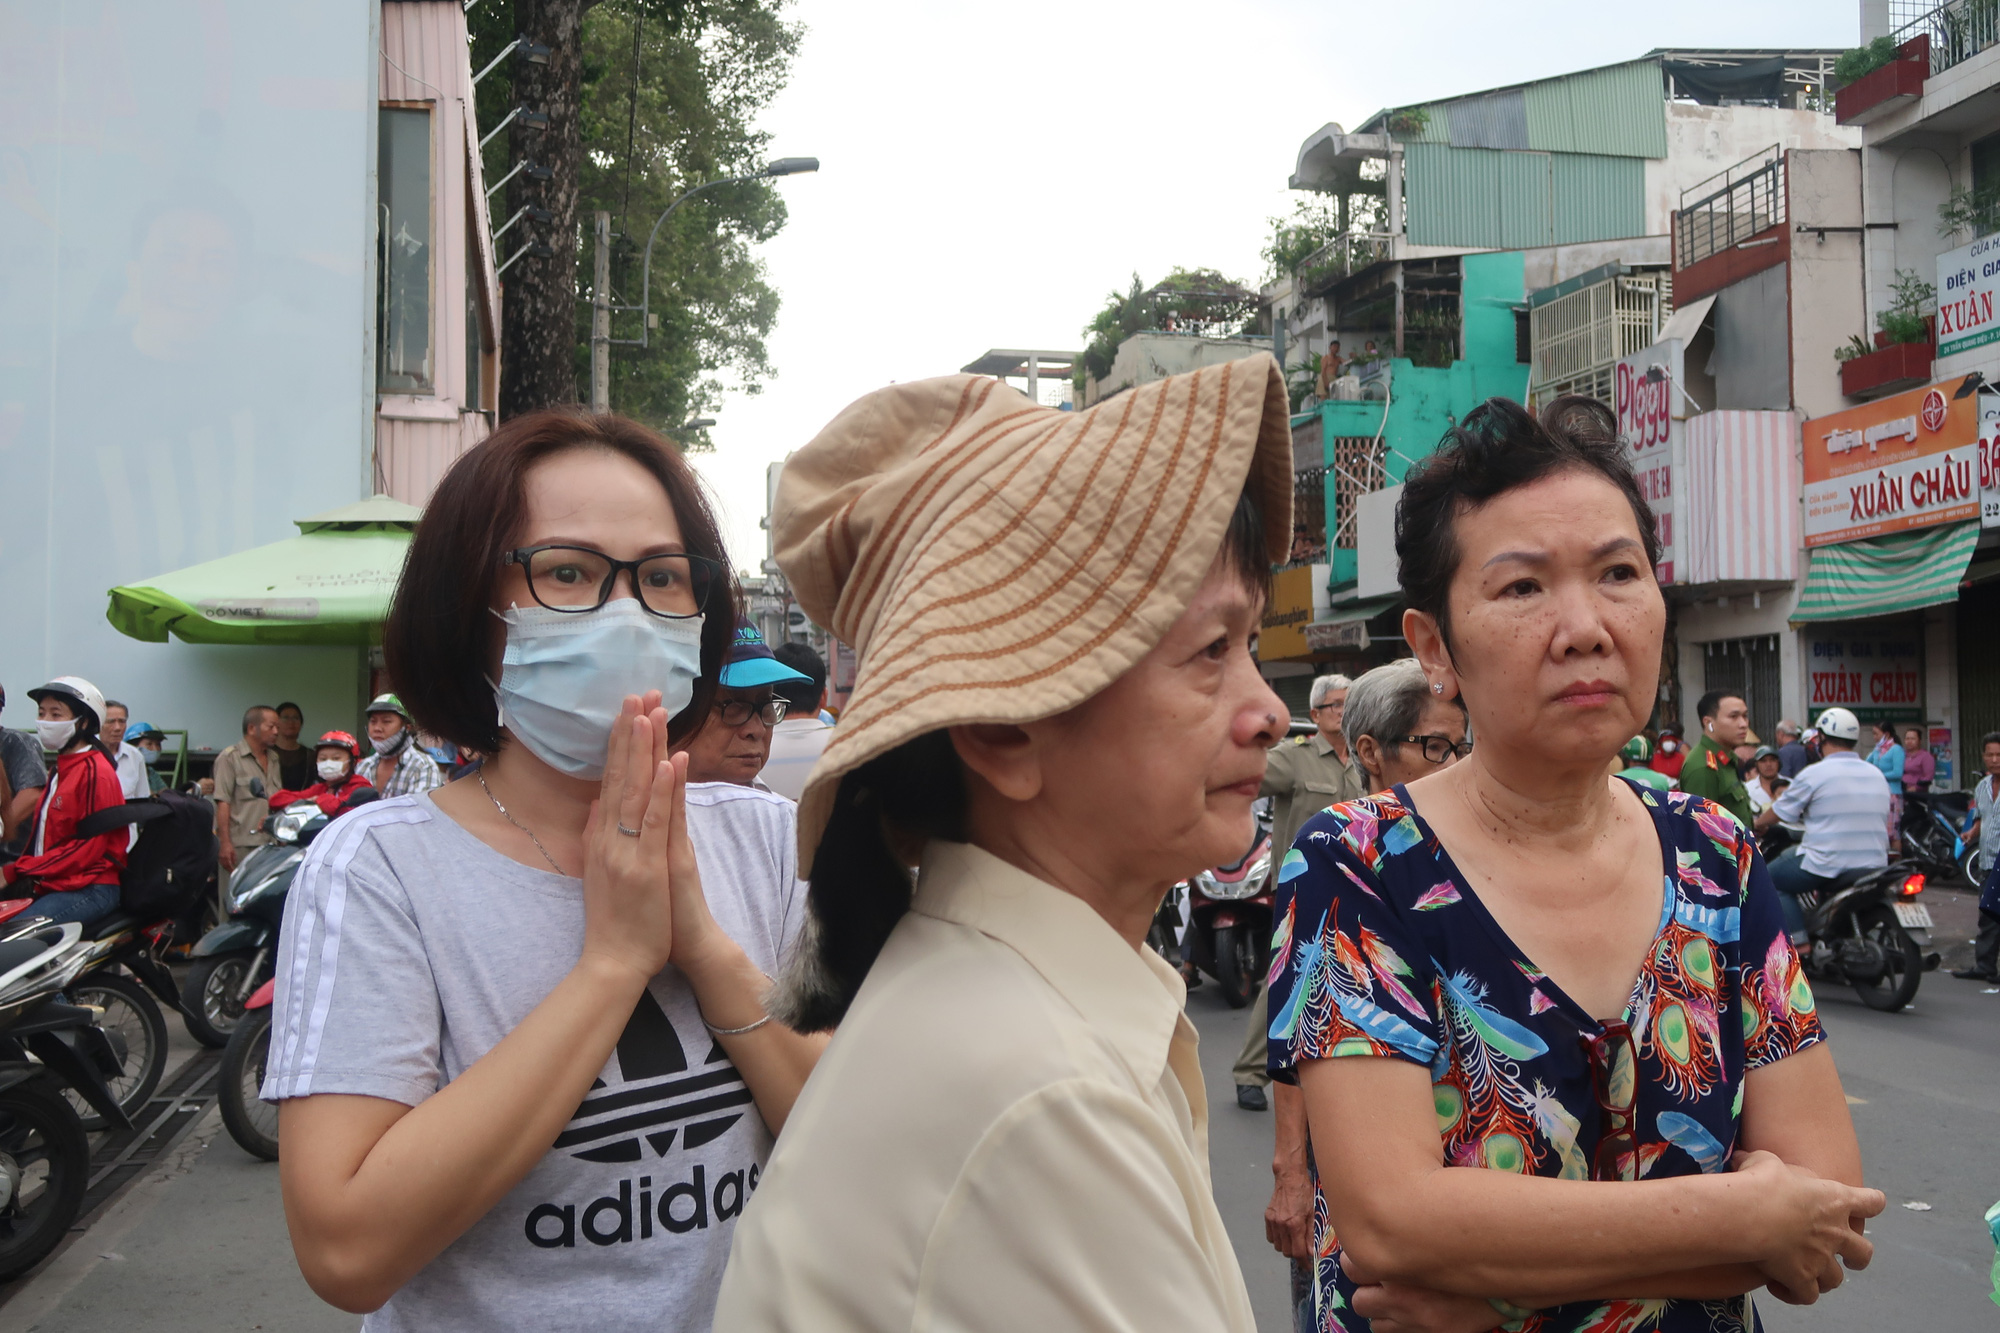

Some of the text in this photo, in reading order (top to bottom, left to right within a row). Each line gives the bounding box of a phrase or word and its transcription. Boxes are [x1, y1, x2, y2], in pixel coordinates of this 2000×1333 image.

[1946, 268, 1976, 290] ĐIỆN
[1940, 289, 1993, 336] XUÂN
[1617, 362, 1671, 450] Piggy
[1850, 454, 1971, 521] XUÂN CHÂU
[1813, 639, 1844, 661] ĐIỆN
[1851, 642, 1872, 657] GIA
[1812, 663, 1917, 703] XUÂN CHÂU
